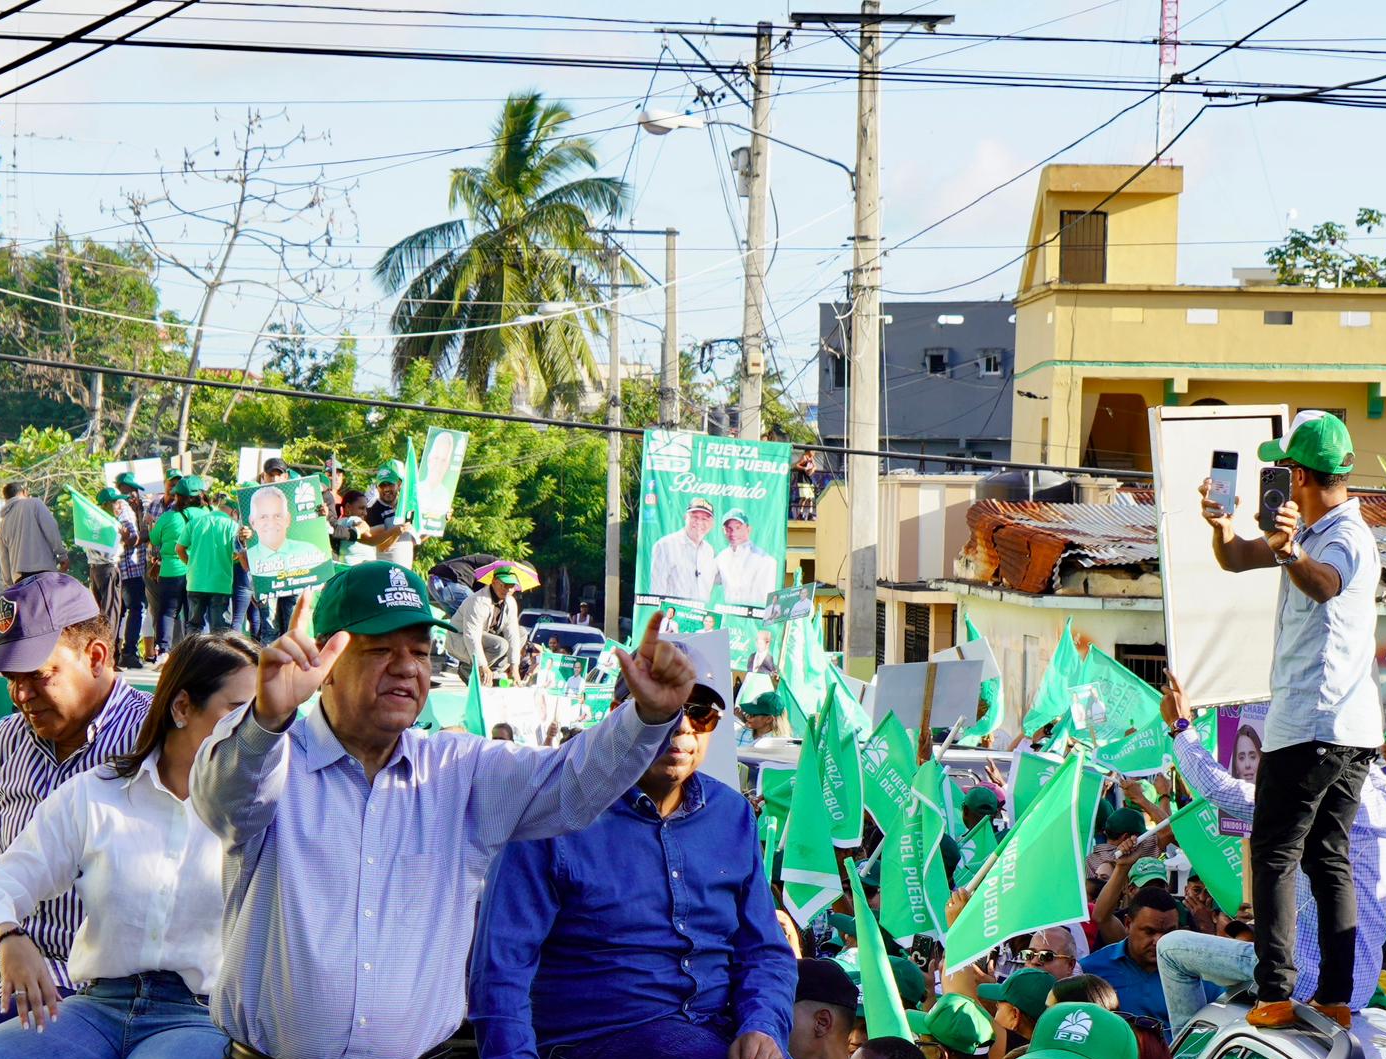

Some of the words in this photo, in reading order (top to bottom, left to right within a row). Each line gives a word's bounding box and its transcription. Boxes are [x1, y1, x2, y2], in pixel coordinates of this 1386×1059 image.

[706, 443, 759, 459] FUERZA
[705, 457, 731, 469] DEL
[735, 459, 790, 475] PUEBLO
[669, 472, 768, 500] Bienvenido
[377, 592, 424, 606] LEONEL
[879, 778, 894, 799] DEL
[1222, 820, 1242, 830] UNIDOS
[900, 834, 913, 863] DEL
[1222, 846, 1243, 874] DEL
[905, 867, 926, 924] PUEBLO
[983, 876, 999, 938] PUEBLO
